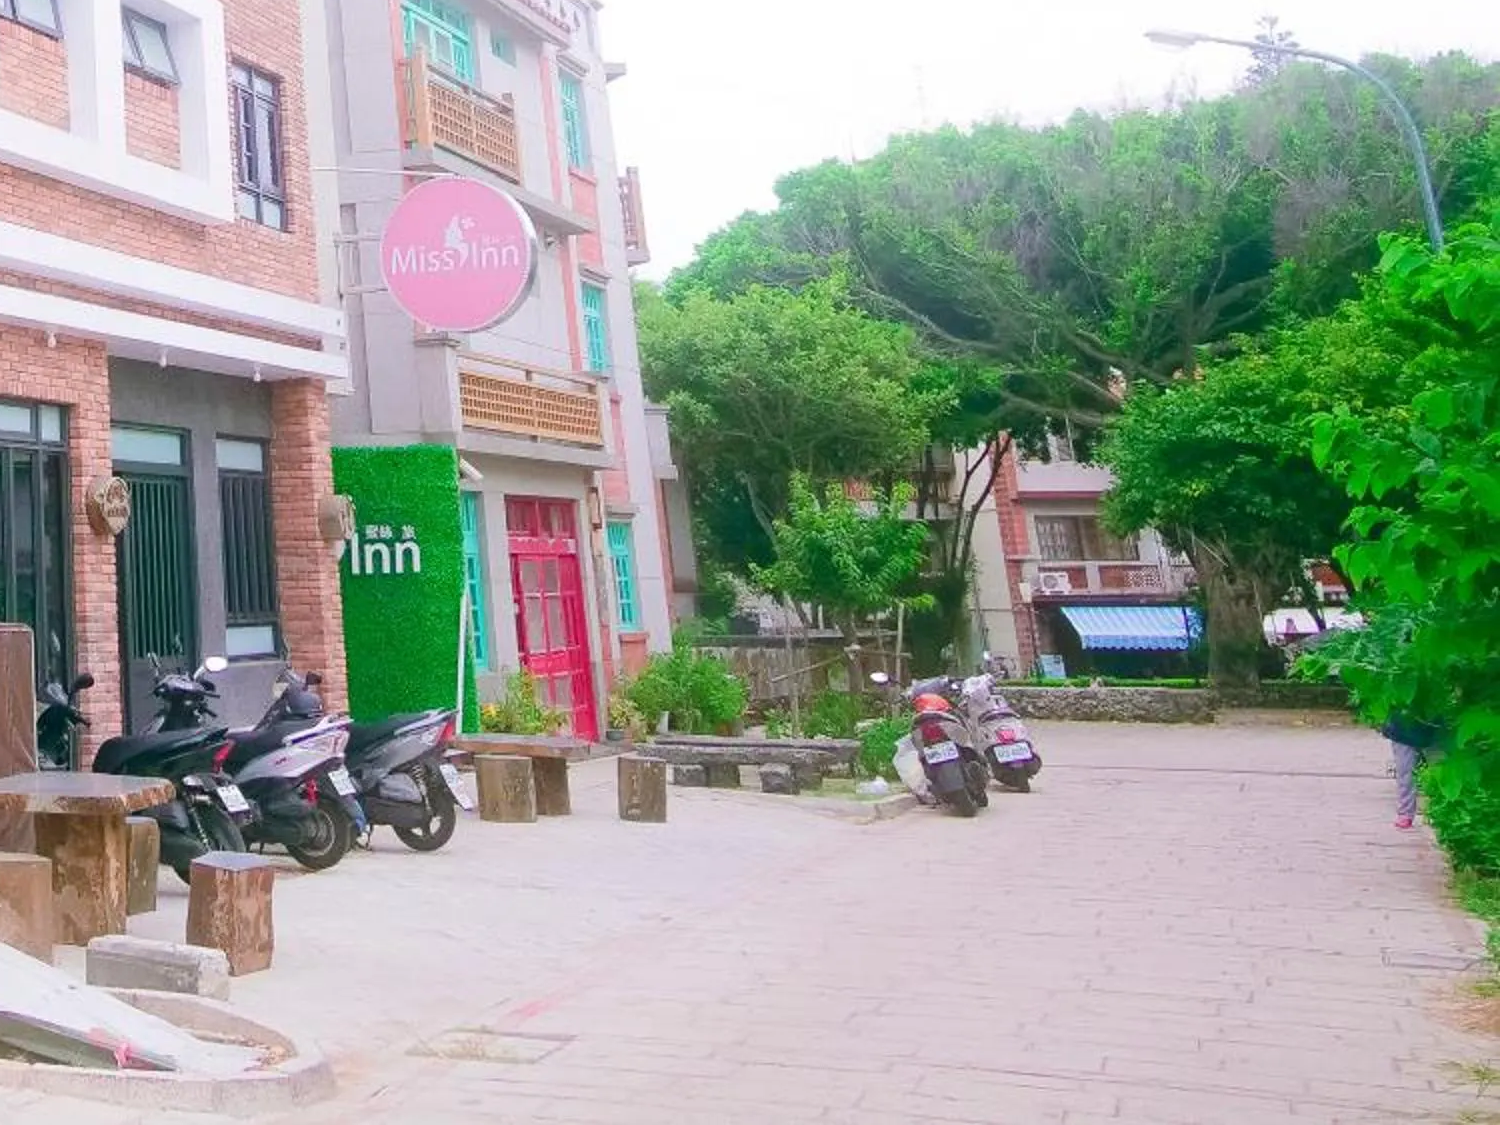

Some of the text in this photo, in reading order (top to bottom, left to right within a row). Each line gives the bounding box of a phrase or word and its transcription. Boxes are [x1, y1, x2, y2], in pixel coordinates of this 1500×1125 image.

[391, 241, 519, 276] Miss Inn
[351, 532, 421, 575] Inn
